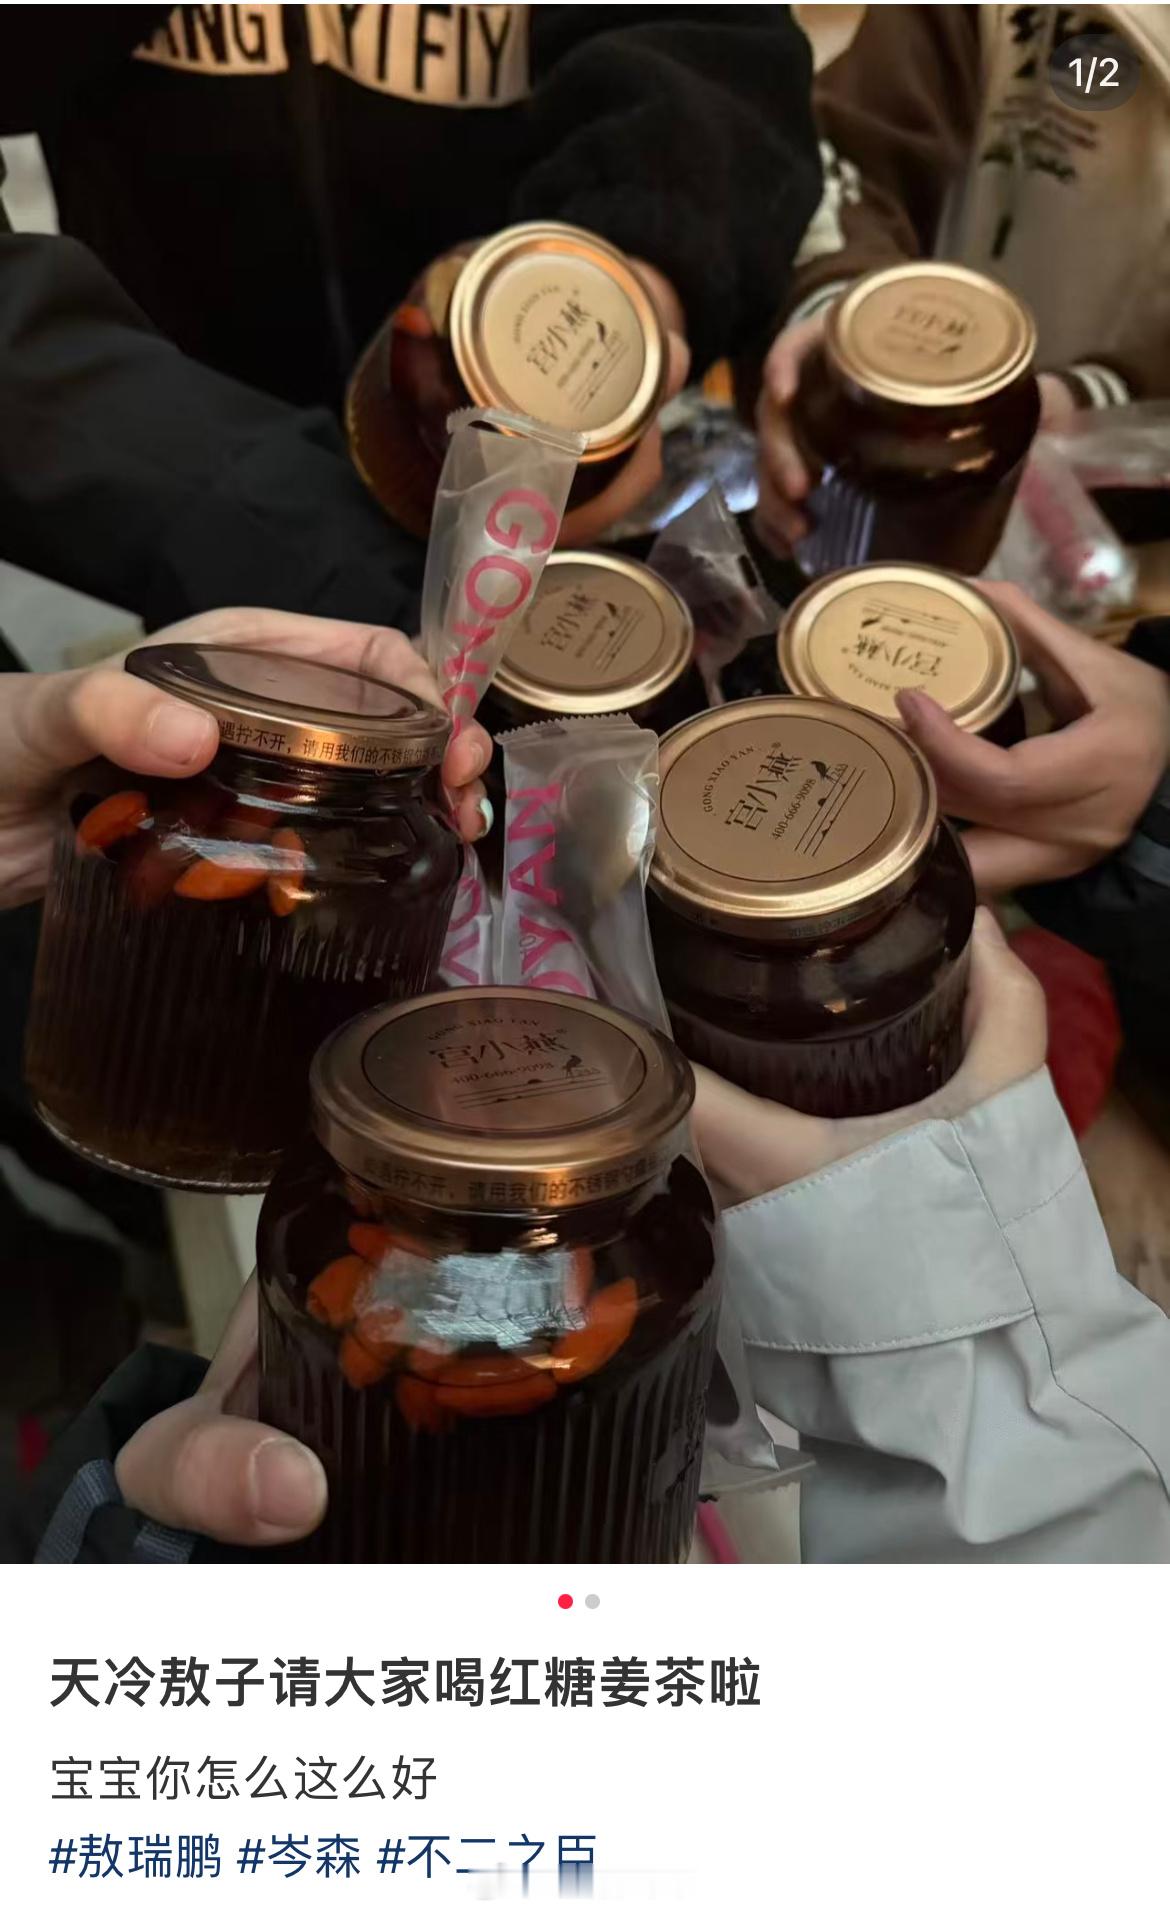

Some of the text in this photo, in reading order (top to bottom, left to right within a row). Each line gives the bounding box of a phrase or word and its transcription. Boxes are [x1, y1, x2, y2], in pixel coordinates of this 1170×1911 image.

[725, 750, 802, 831] 宫小燕
[428, 1033, 570, 1068] 宫小燕
